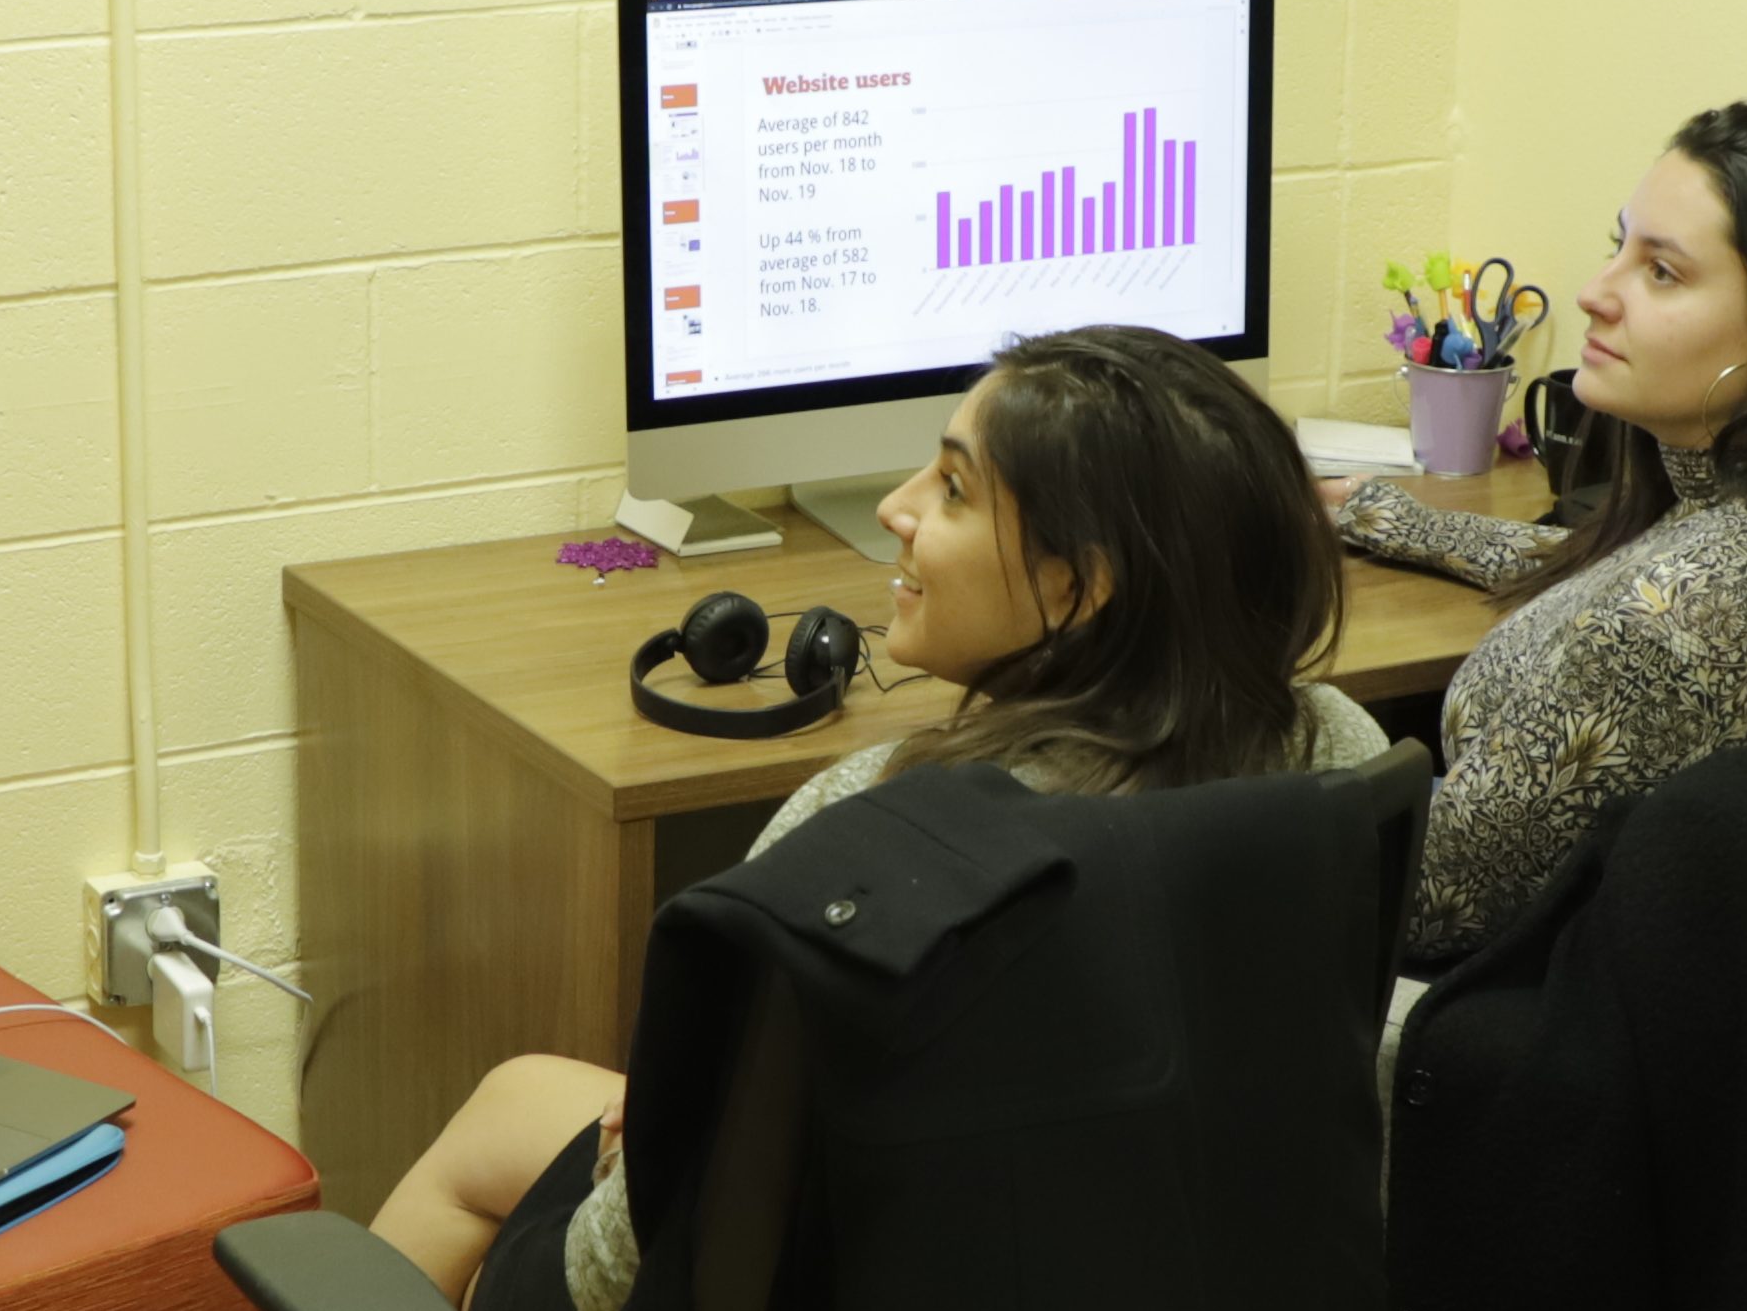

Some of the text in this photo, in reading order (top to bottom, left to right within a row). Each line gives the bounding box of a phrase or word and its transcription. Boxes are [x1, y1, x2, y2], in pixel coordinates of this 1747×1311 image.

[763, 72, 911, 95] Website users
[758, 110, 869, 133] Average of 842
[758, 131, 882, 155] users per month
[758, 158, 876, 180] from Nov. 18 to
[759, 183, 815, 202] Nov. 19
[759, 227, 862, 251] Up 44 % from
[759, 248, 869, 272] average of 582
[759, 271, 876, 294] from Nov. 17 to
[760, 298, 821, 317] Nov. 18.
